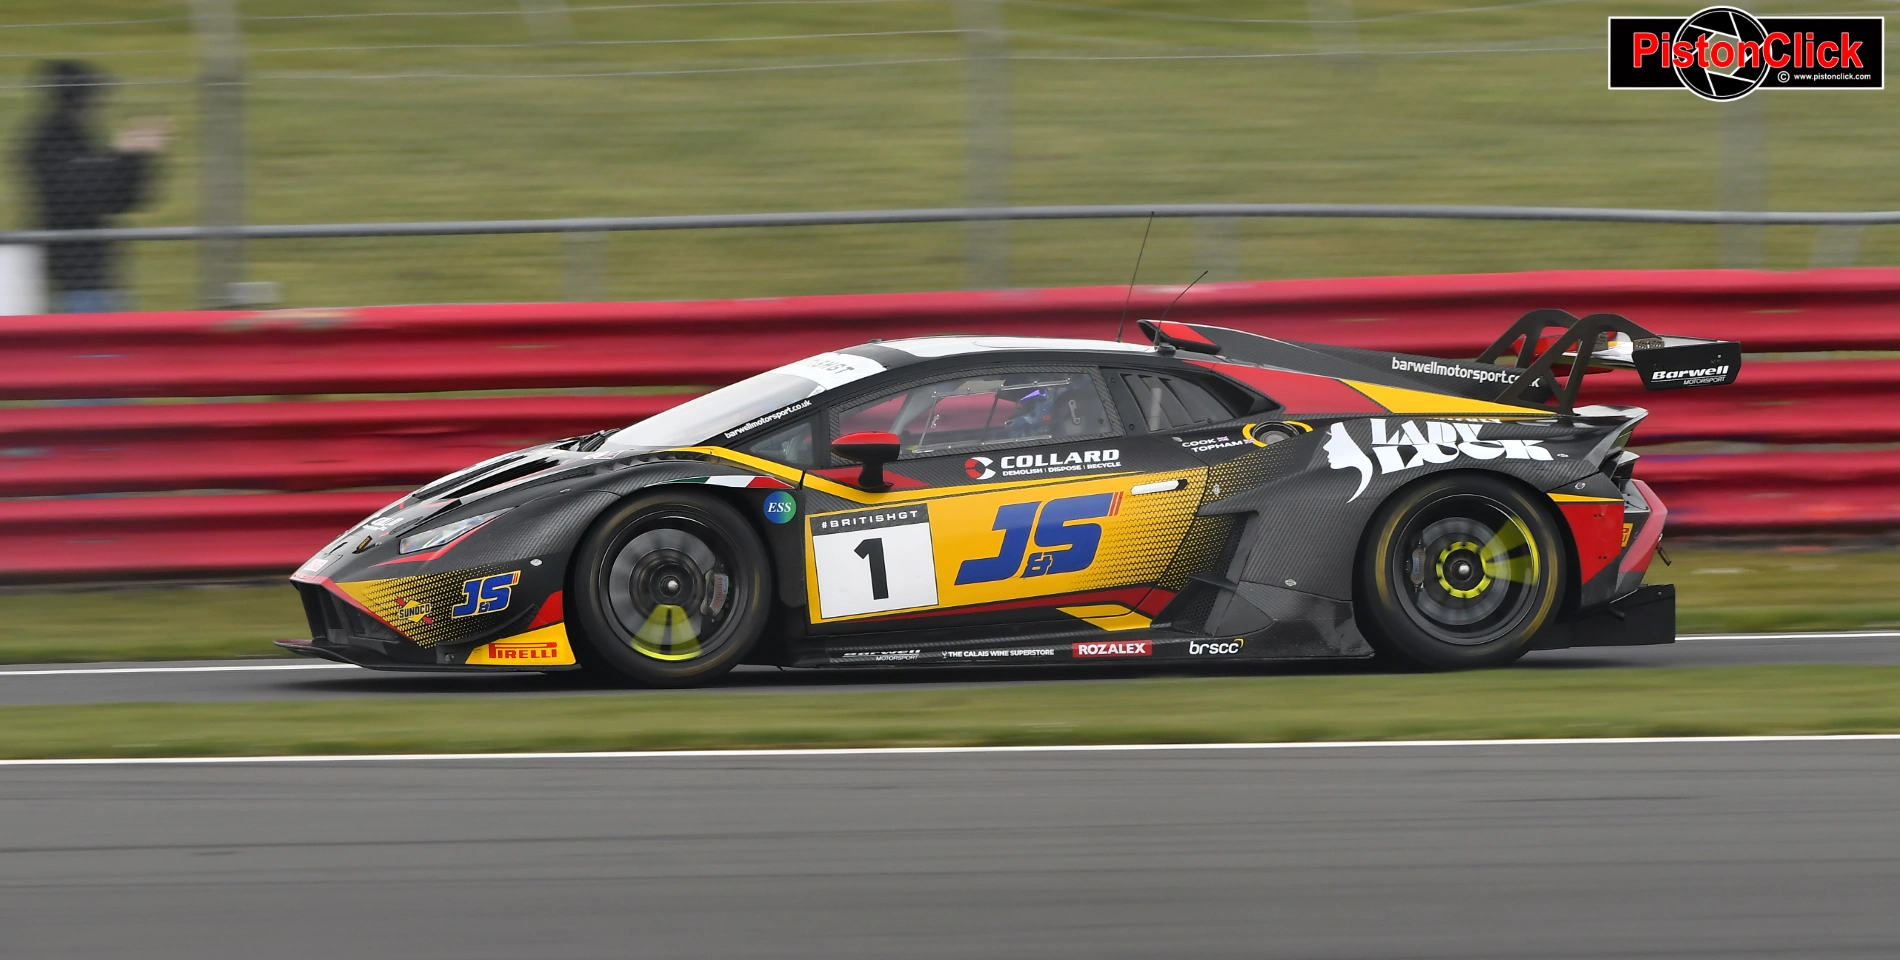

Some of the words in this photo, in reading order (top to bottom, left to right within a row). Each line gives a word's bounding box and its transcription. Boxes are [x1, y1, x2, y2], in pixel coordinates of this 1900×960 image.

[1652, 365, 1729, 380] Barwell
[1683, 376, 1726, 386] MOTORSPORT
[724, 399, 812, 439] barwellmotorsport.co.uk
[1370, 418, 1483, 445] LADY
[1182, 438, 1217, 448] COOK
[1191, 440, 1243, 453] TOPHAM
[1001, 449, 1120, 469] COLLARD
[1372, 440, 1554, 474] LUCK
[1003, 467, 1043, 476] DEMOLISH
[1048, 464, 1082, 473] DISPOSE
[1087, 461, 1122, 470] RECYCLE
[767, 502, 792, 513] ESS
[821, 510, 918, 529] #BRITISHGT
[854, 537, 889, 601] 1
[398, 603, 431, 619] SUNOCO
[489, 642, 557, 658] PIRELLI
[1078, 643, 1146, 655] ROZALEX
[1189, 641, 1239, 655] brscc
